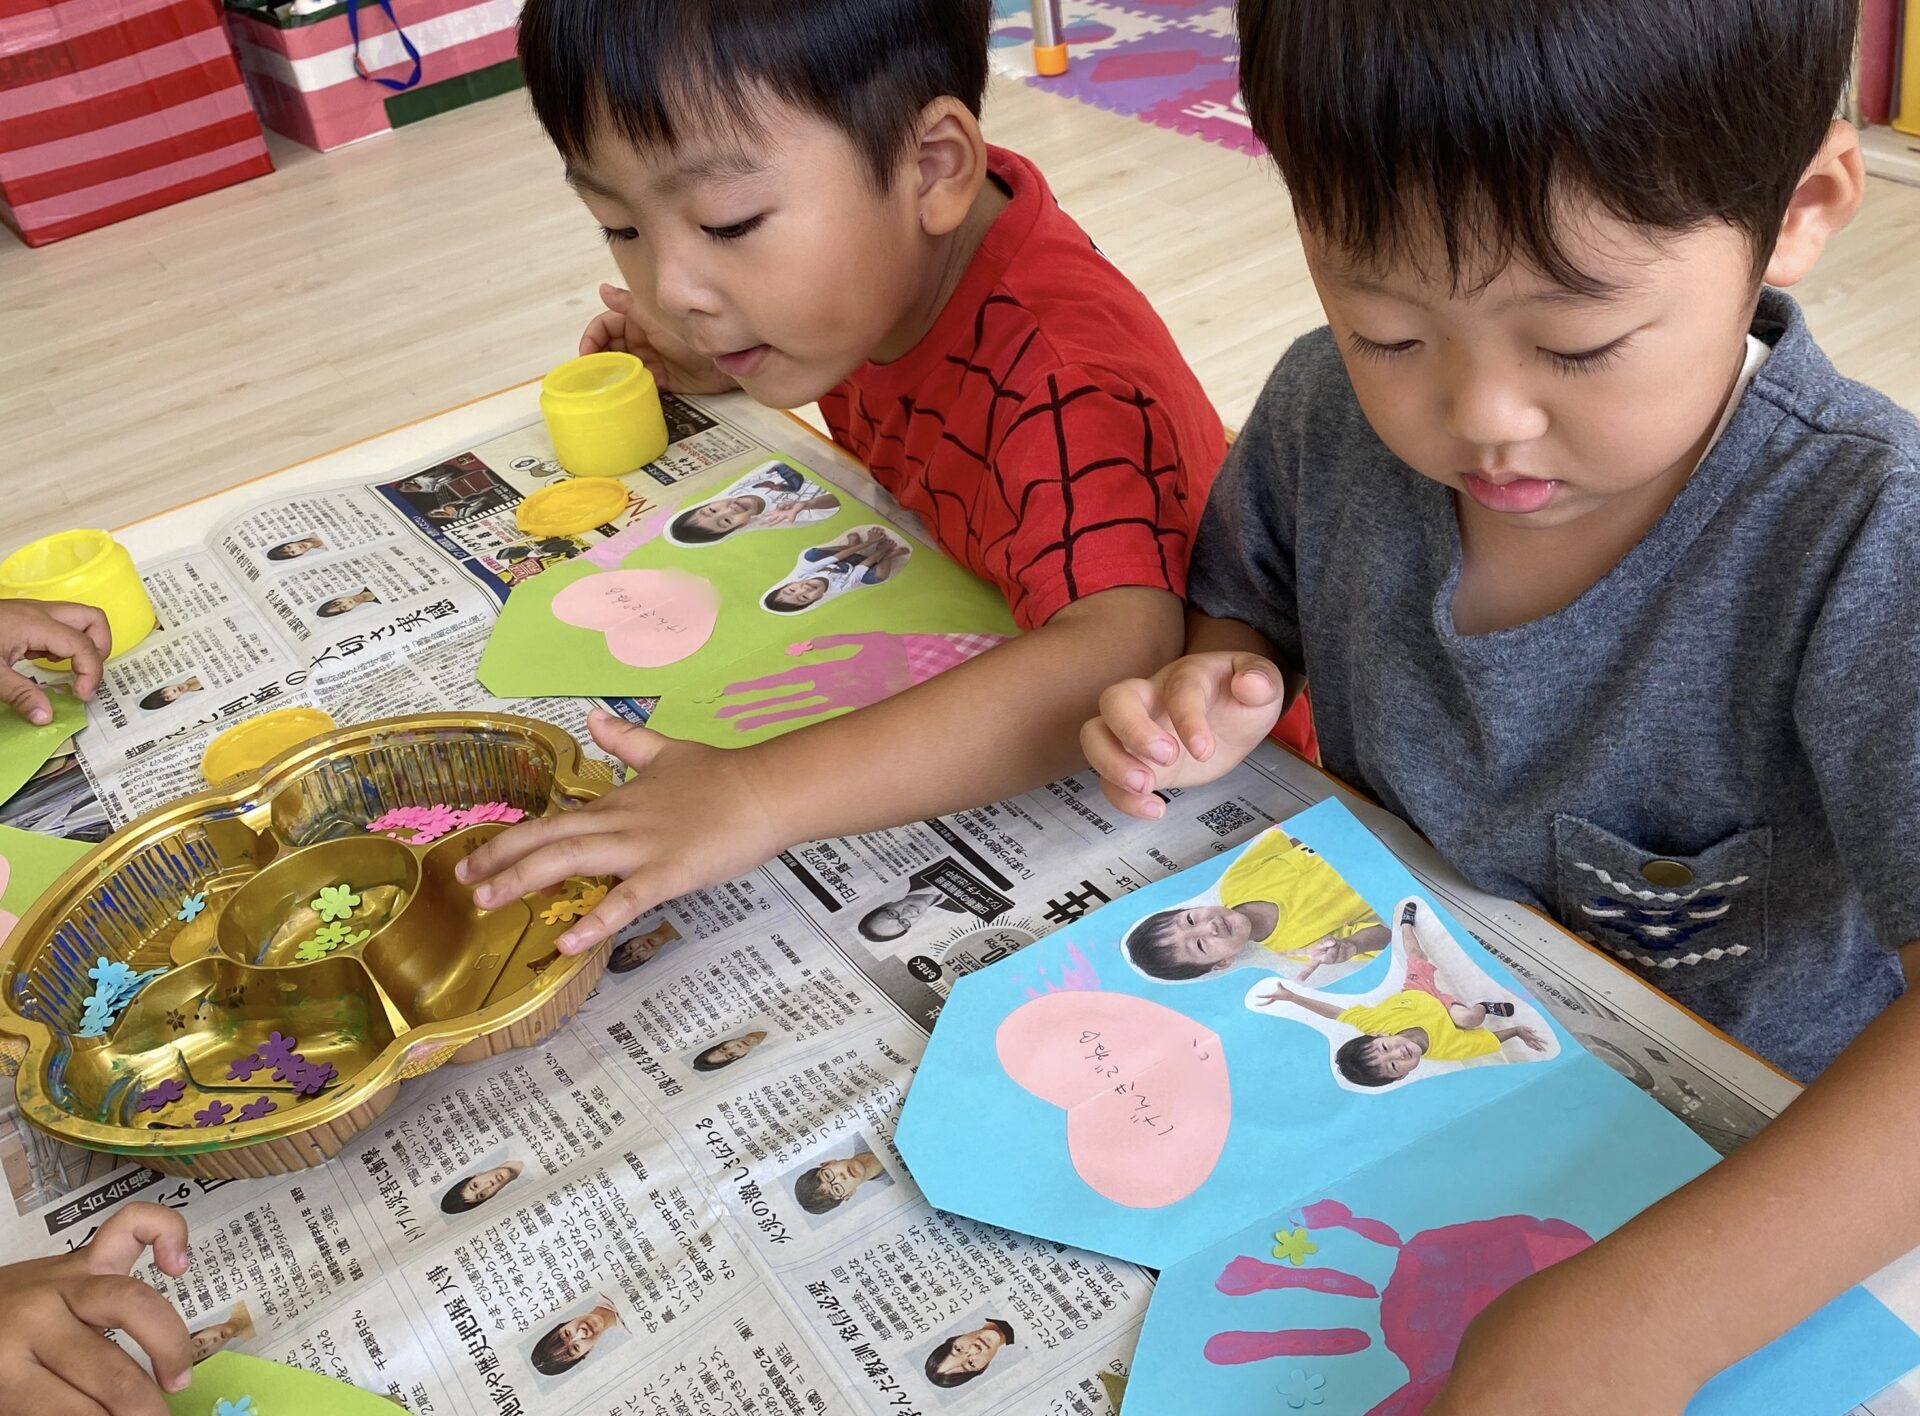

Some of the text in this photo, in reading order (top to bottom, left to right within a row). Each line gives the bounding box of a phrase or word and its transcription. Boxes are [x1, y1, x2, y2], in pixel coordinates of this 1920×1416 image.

[125, 598, 459, 760] 備えと判断の大切さ実感
[606, 1020, 683, 1098] 印象に残る裏山避難
[359, 1145, 425, 1242] トリプル災害に衝撃
[691, 1114, 794, 1249] 火災の激しさ伝わる
[451, 1244, 509, 1332] 今まで災害が起き
[466, 1234, 532, 1333] なかったから大丈夫
[482, 1224, 547, 1322] という考えは役に立
[714, 1258, 736, 1281] さん
[860, 1248, 931, 1334] ければならなかった
[876, 1240, 946, 1324] ことに衝撃を受け
[890, 1231, 962, 1315] た。鈴木さんが話し
[905, 1223, 976, 1306] ていたように、これ
[919, 1214, 991, 1296] からは私たちが学ん
[424, 1261, 526, 1416] 地形や歴史把握 大事
[803, 1276, 865, 1345] 発信必要
[829, 1264, 893, 1342] 地震発生後、4回
[845, 1256, 916, 1343] も避難場所を変えな
